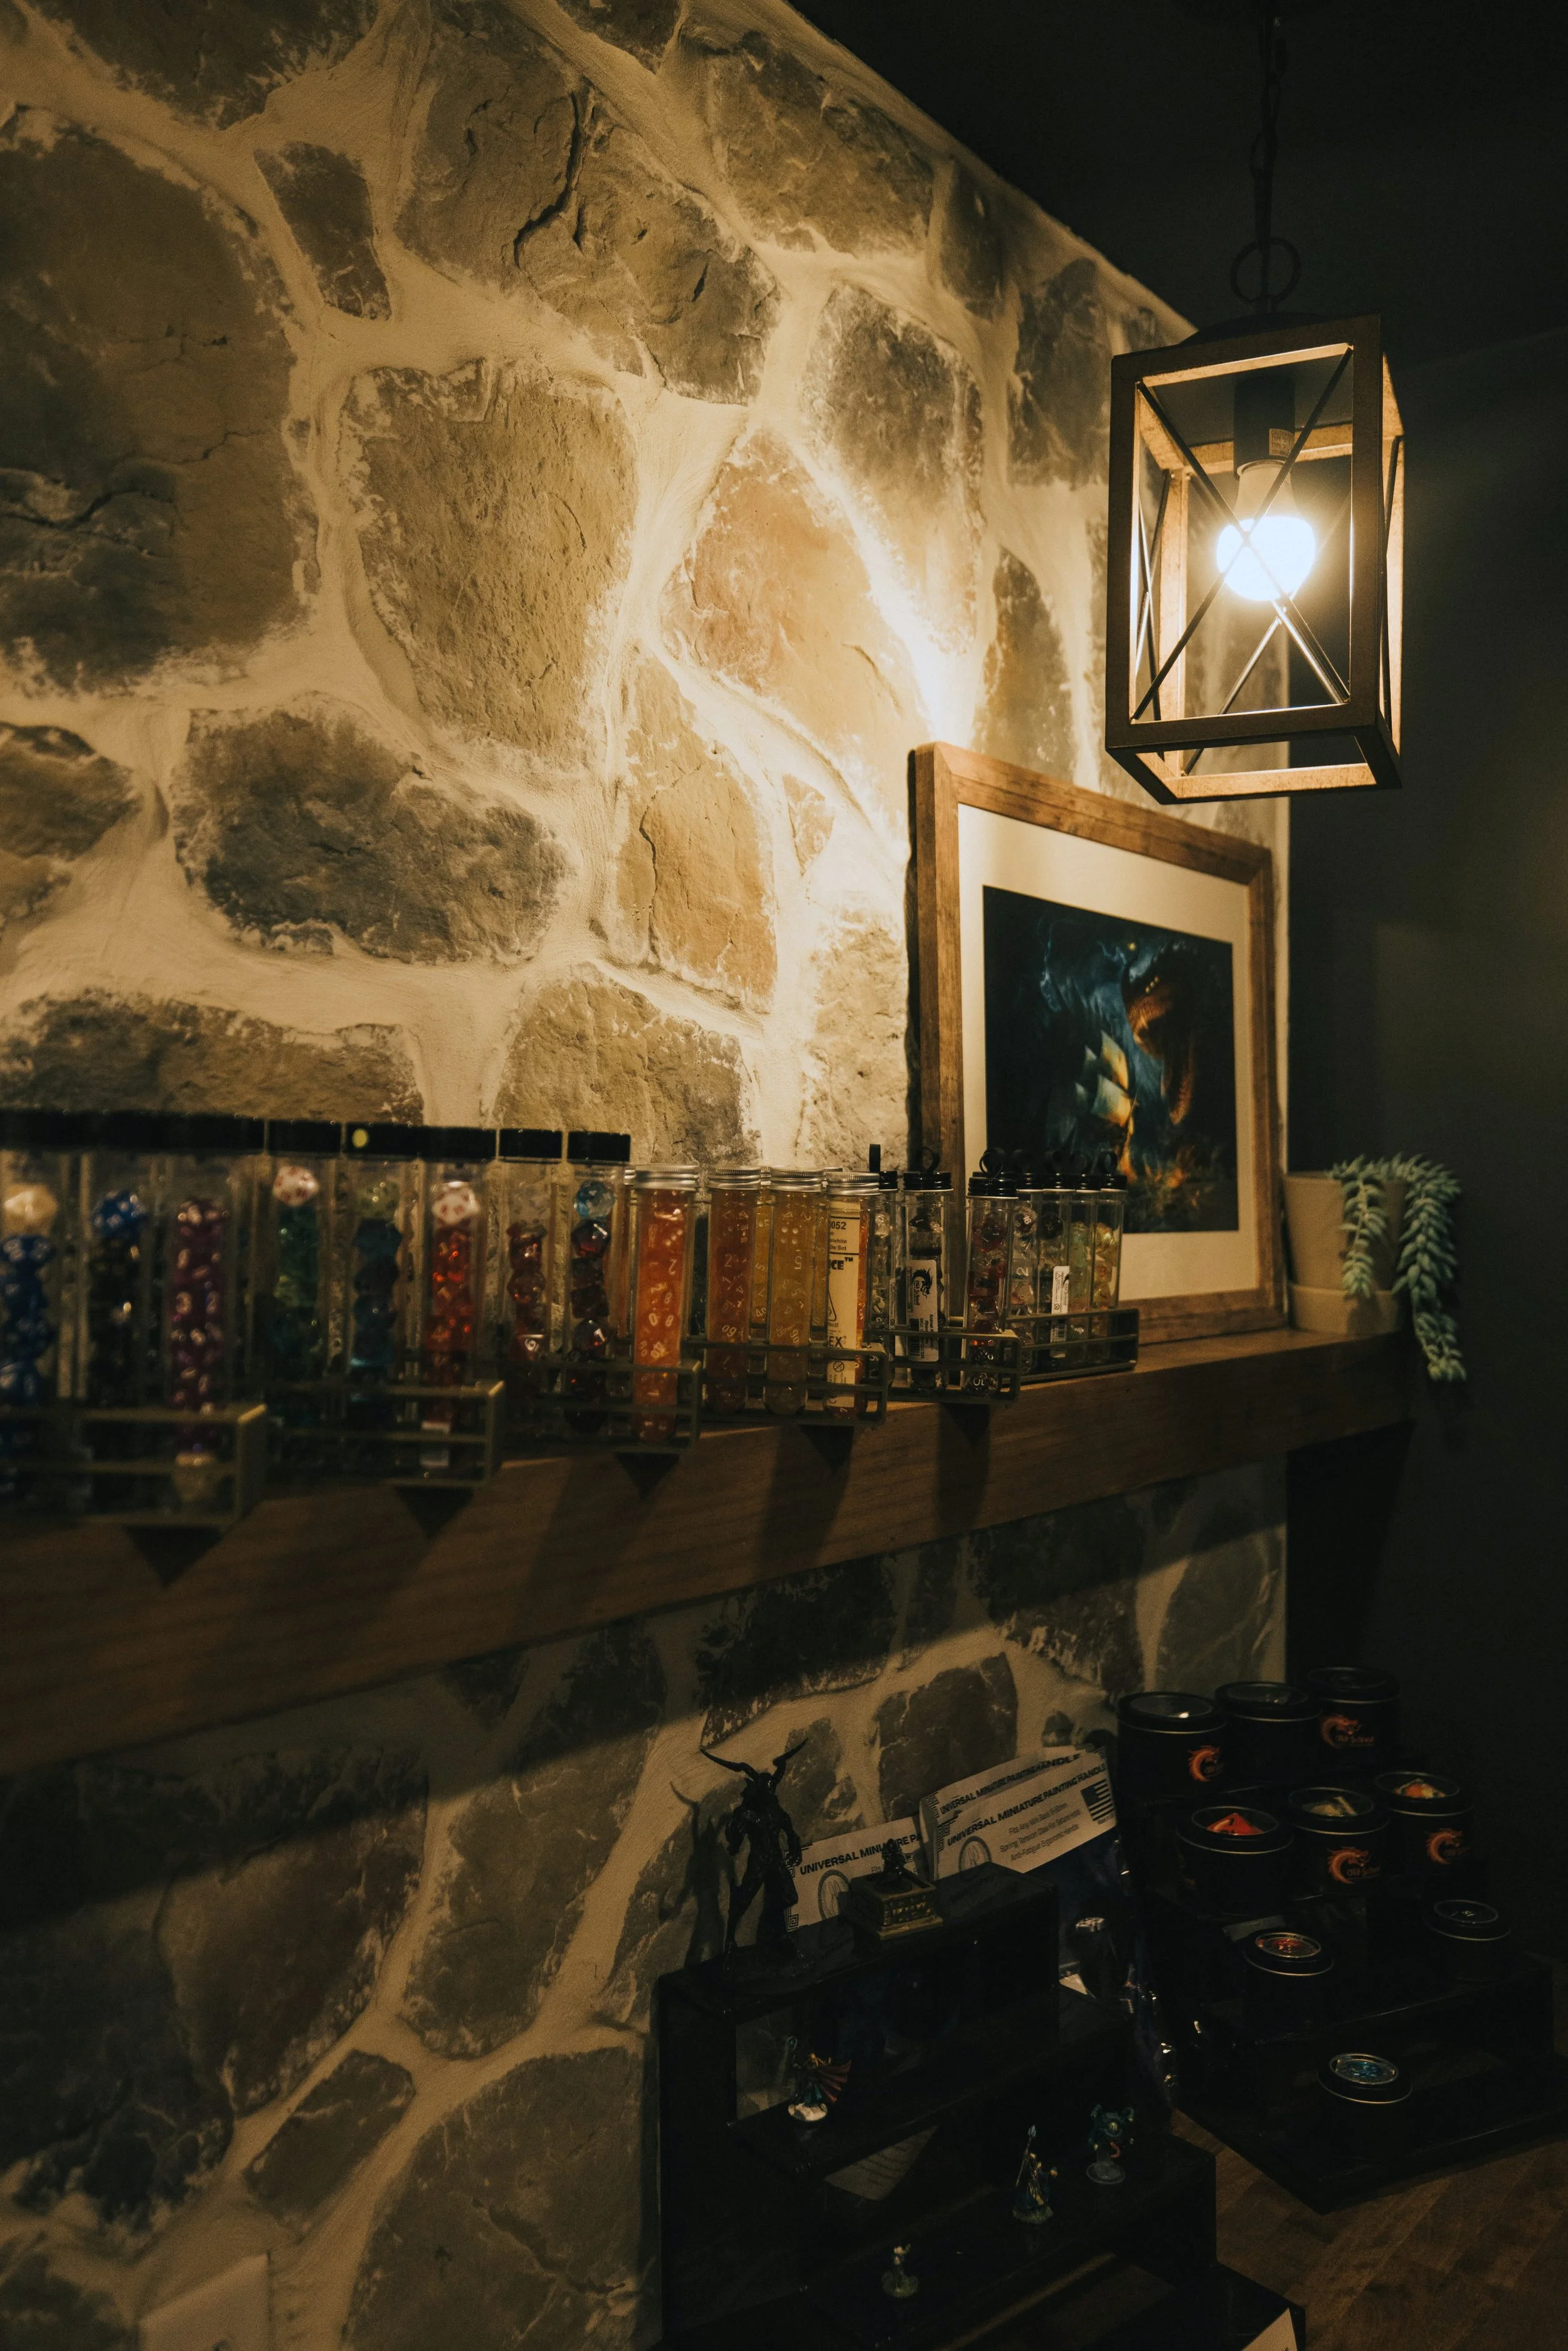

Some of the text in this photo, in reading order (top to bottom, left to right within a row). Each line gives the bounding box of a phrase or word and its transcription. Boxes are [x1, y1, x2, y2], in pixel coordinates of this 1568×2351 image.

[940, 1793, 977, 1815] UNIVERSAL
[975, 1777, 1006, 1798] MINIATURE
[947, 1763, 1106, 1846] UNIVERSAL MINIATURE PAINTING HANDLE
[999, 1840, 1019, 1853] Spring
[1019, 1832, 1038, 1845] Tension
[1010, 1843, 1041, 1862] Anti-Fatigue
[800, 1852, 860, 1875] UNIVERSAL
